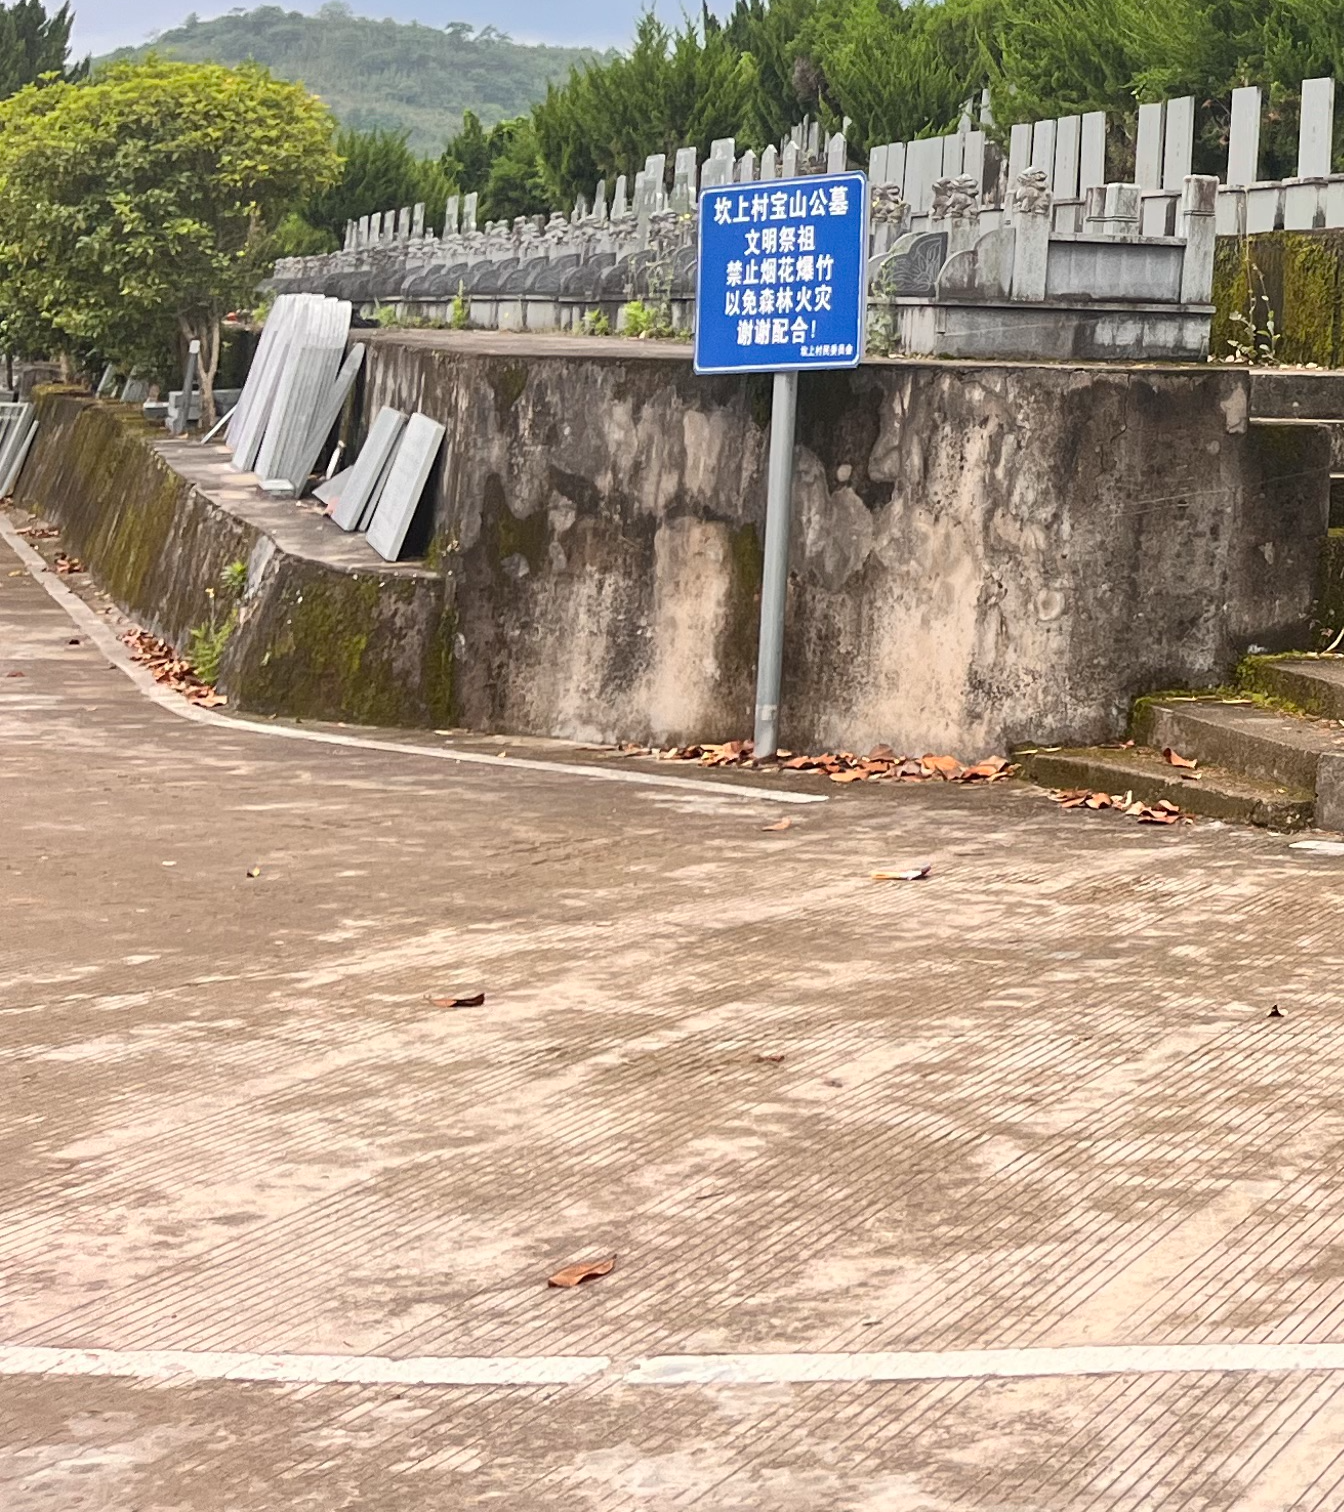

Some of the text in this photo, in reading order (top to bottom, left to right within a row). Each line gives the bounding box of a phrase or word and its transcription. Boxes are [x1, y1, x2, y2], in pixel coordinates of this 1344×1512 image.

[713, 186, 849, 225] 坎上村宝山公墓
[744, 225, 815, 256] 文明祭祖
[726, 254, 834, 287] 禁止烟花爆竹
[724, 284, 832, 316] 以免森林火灾
